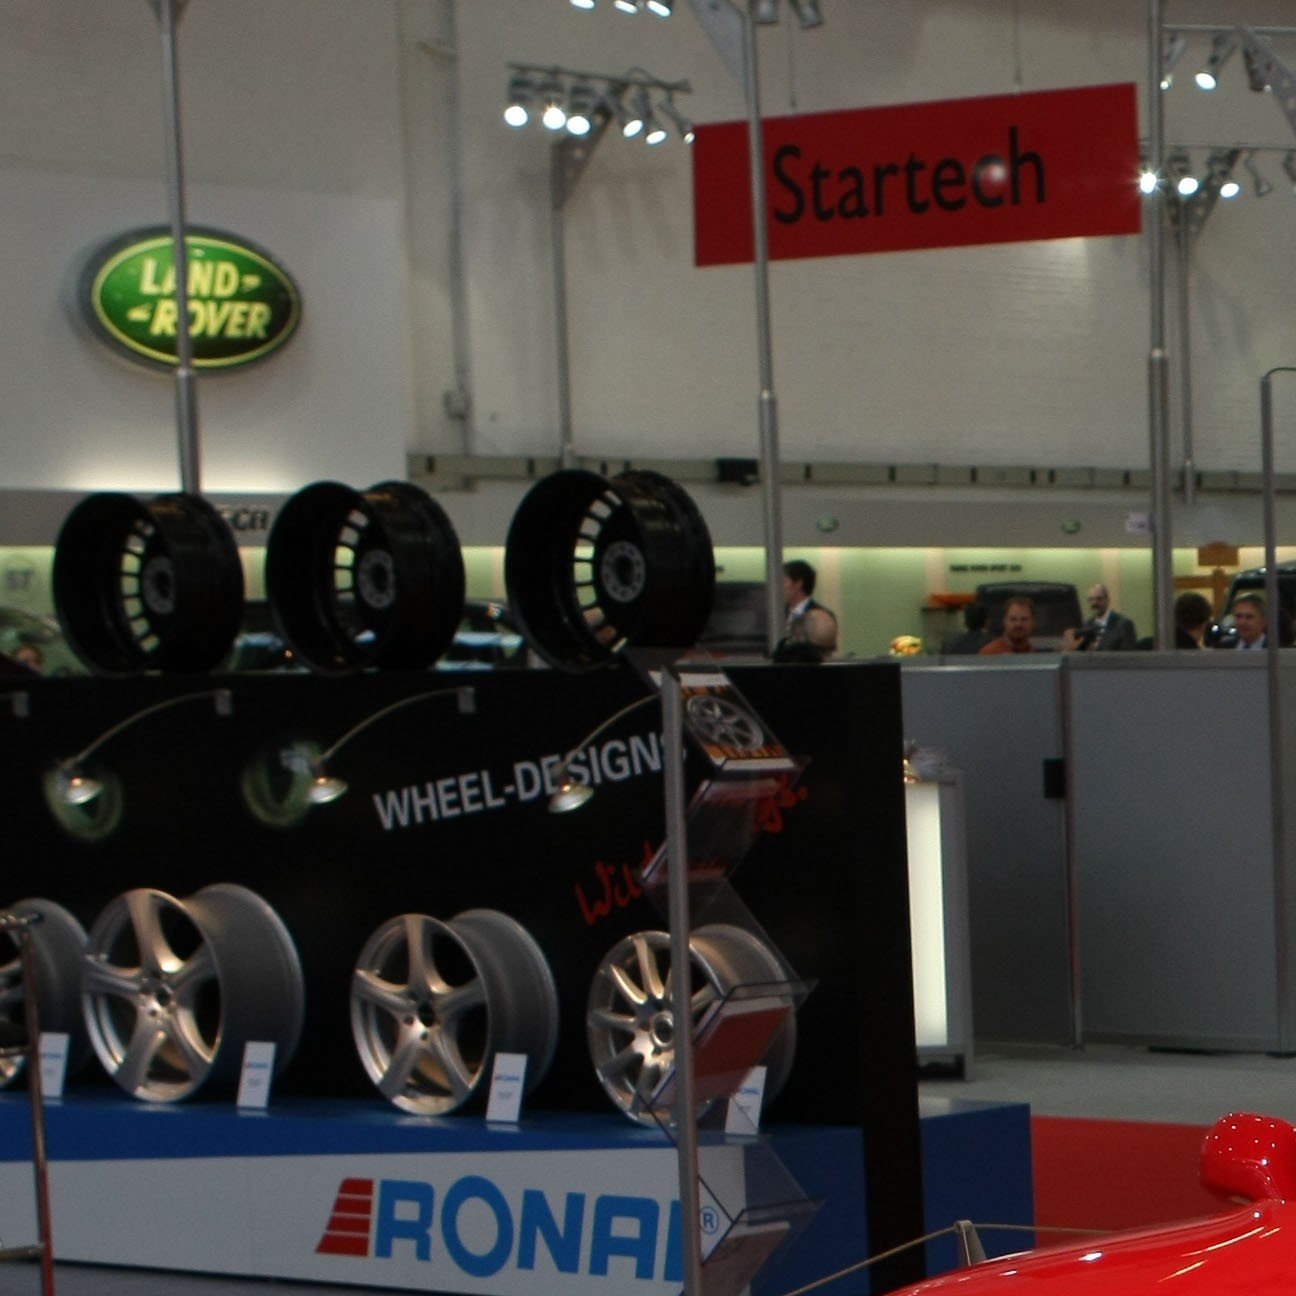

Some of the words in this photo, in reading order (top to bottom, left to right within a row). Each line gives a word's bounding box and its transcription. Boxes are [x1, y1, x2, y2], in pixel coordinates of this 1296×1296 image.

[772, 125, 1046, 224] Startech
[150, 299, 271, 338] ROVER
[373, 730, 687, 831] WHEEL-DESIGN
